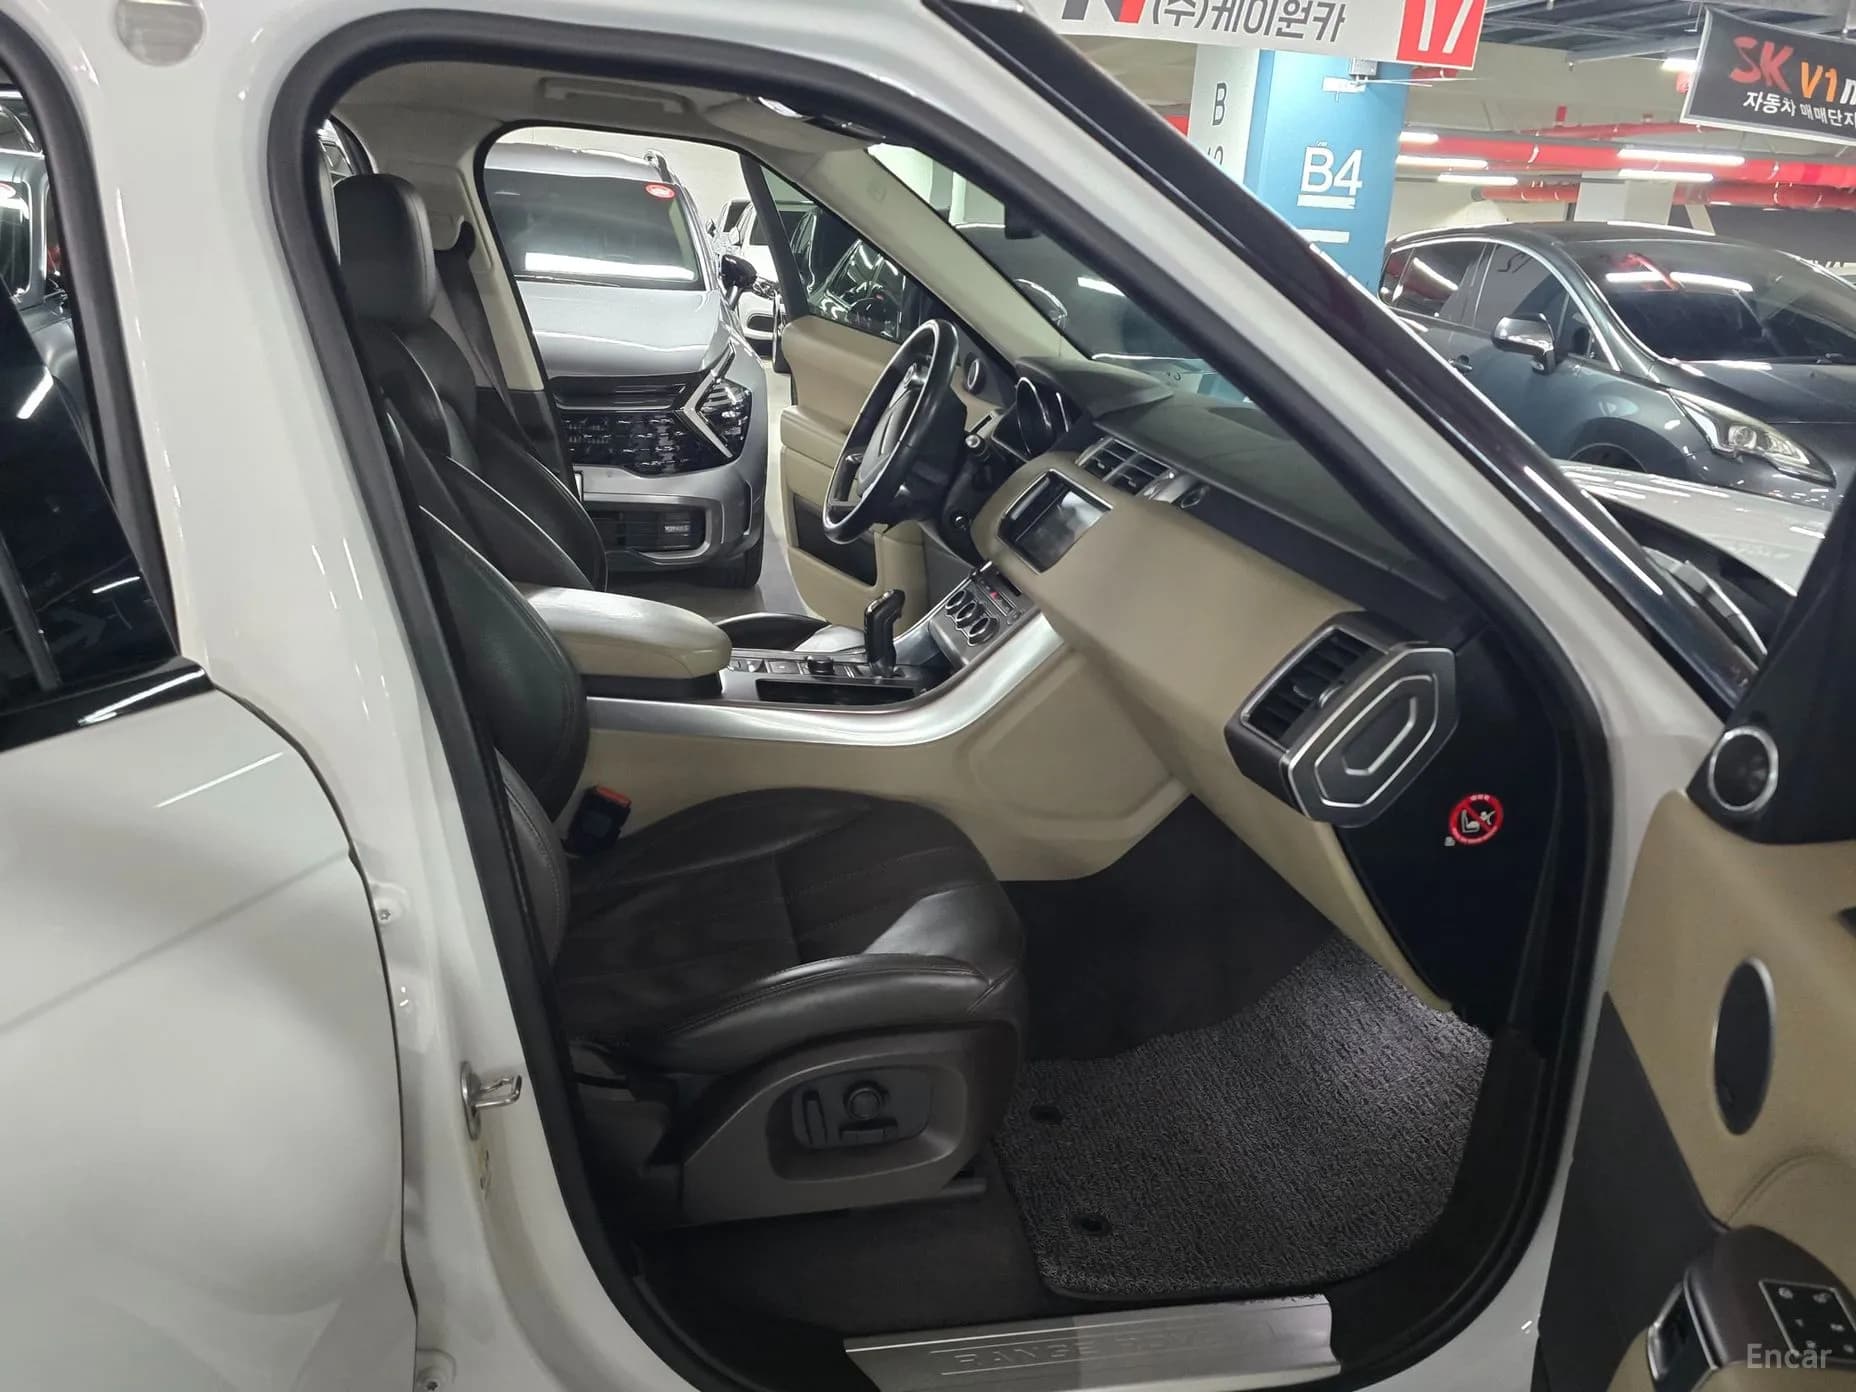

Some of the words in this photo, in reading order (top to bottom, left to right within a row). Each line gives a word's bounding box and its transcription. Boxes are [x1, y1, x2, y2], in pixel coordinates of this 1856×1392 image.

[1153, 0, 1346, 42] (주)케이원카
[1730, 36, 1794, 93] SK
[1801, 61, 1838, 103] V1
[1212, 82, 1227, 126] B
[1743, 91, 1796, 117] 자동차
[1301, 147, 1363, 196] B4
